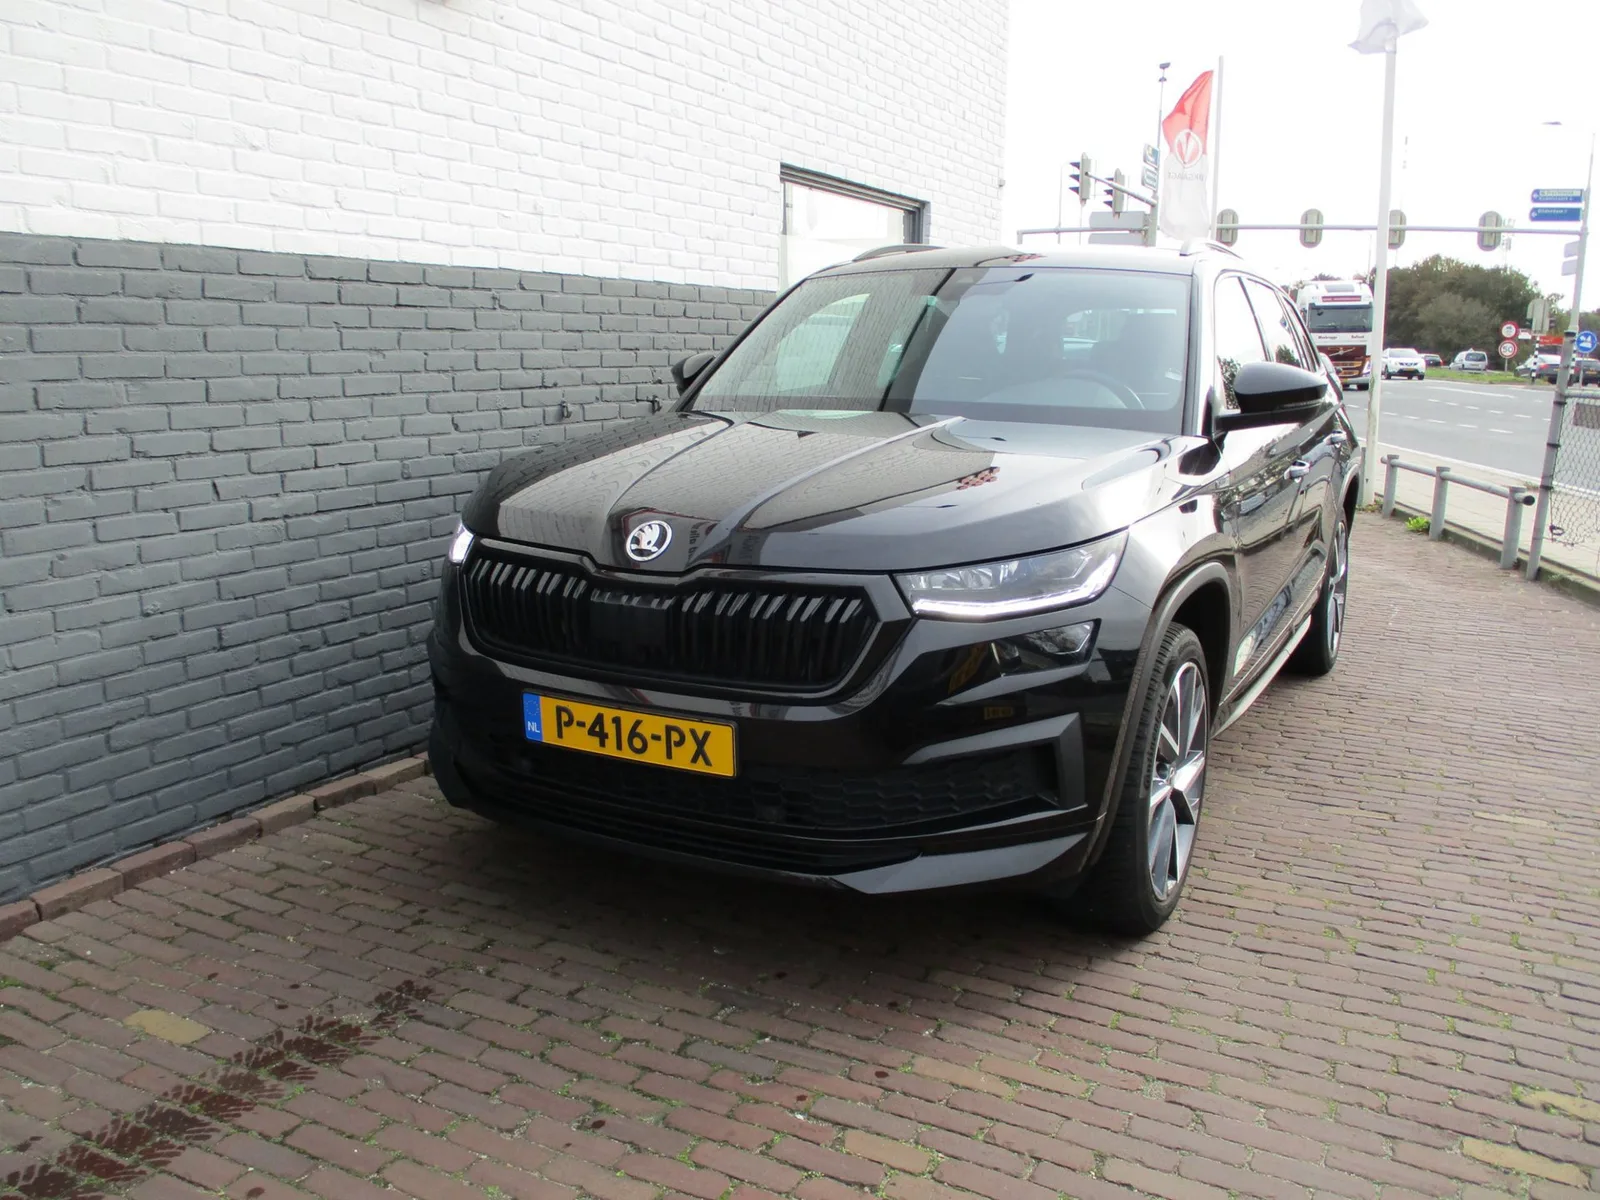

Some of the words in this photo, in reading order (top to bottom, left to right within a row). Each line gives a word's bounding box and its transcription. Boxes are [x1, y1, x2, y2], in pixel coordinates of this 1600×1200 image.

[1502, 344, 1514, 353] 50
[527, 720, 541, 733] NL
[555, 704, 713, 767] P-416-PX
